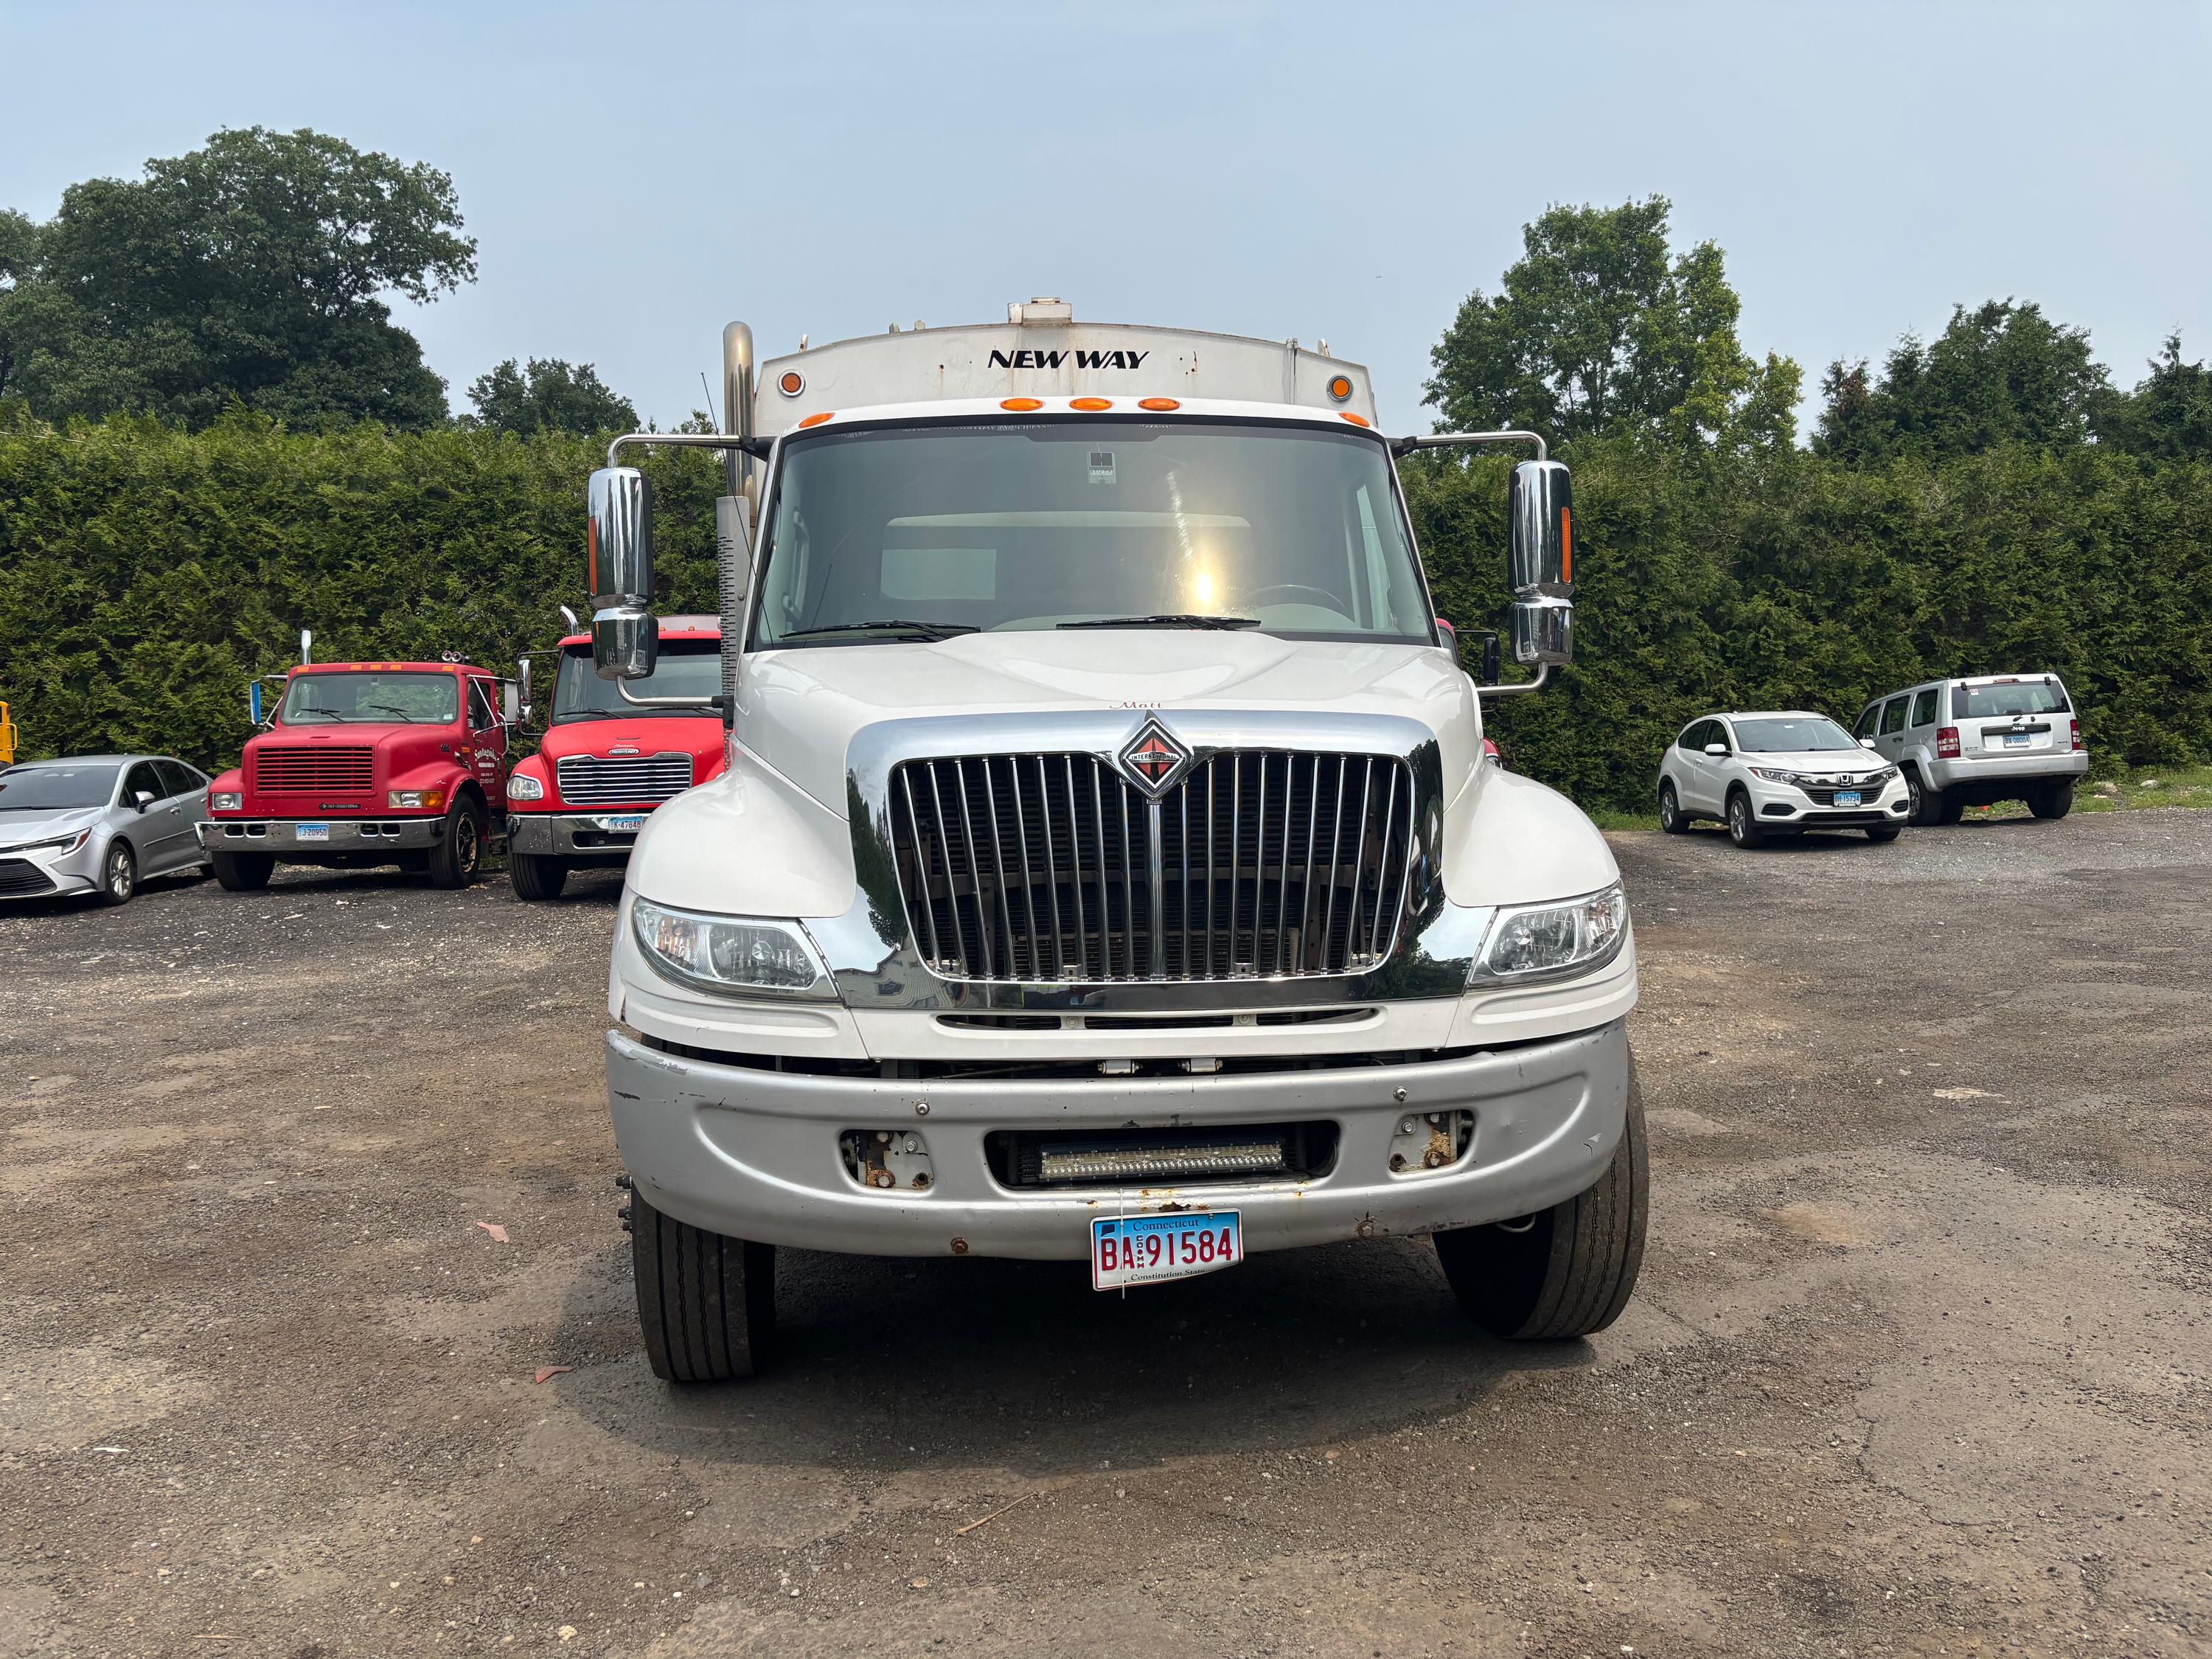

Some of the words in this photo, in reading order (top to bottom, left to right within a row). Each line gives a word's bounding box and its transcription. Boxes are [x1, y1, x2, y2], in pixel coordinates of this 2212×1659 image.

[988, 350, 1069, 369] NEW
[1076, 350, 1150, 369] WAY
[1133, 1219, 1199, 1231] Connecticut
[1130, 1271, 1182, 1281] Constitution
